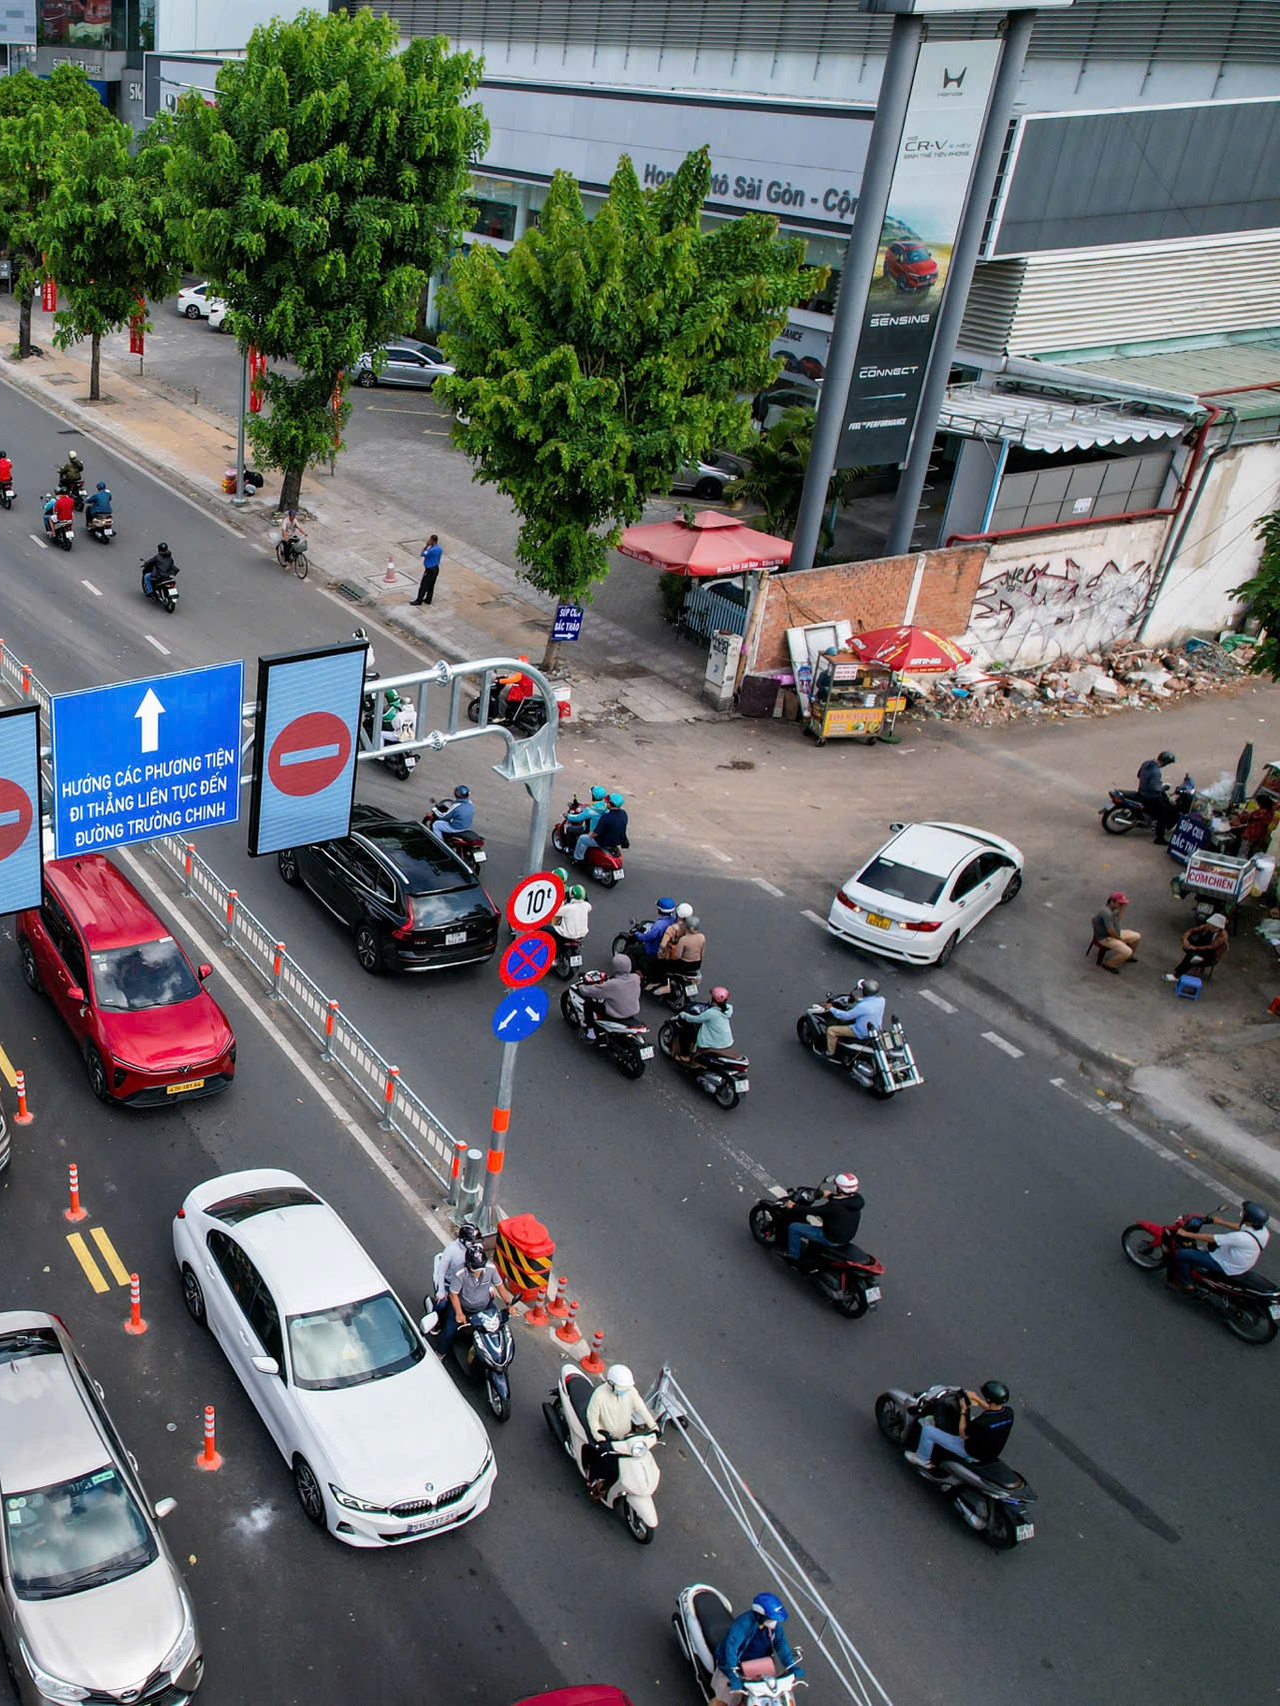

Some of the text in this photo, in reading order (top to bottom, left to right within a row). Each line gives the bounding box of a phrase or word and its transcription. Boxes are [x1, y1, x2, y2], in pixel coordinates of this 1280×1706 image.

[129, 83, 143, 101] SK
[905, 140, 948, 152] CR-V
[733, 175, 763, 201] Sài
[766, 182, 806, 208] Gòn
[823, 188, 861, 219] Cộn
[869, 314, 930, 328] SENSING
[859, 366, 919, 379] CONNECT
[865, 418, 907, 429] PERFORMANCE
[554, 619, 566, 631] BÁC
[62, 748, 234, 798] HƯỚNG CÁC PHƯƠNG TIỆN
[70, 771, 227, 822] ĐI THẲNG LIÊN TỤC ĐẾN
[75, 801, 226, 847] ĐƯỜNG TRƯỜNG CHINH
[1171, 831, 1199, 854] BÁC THẢ
[1208, 876, 1234, 891] CHIÊN
